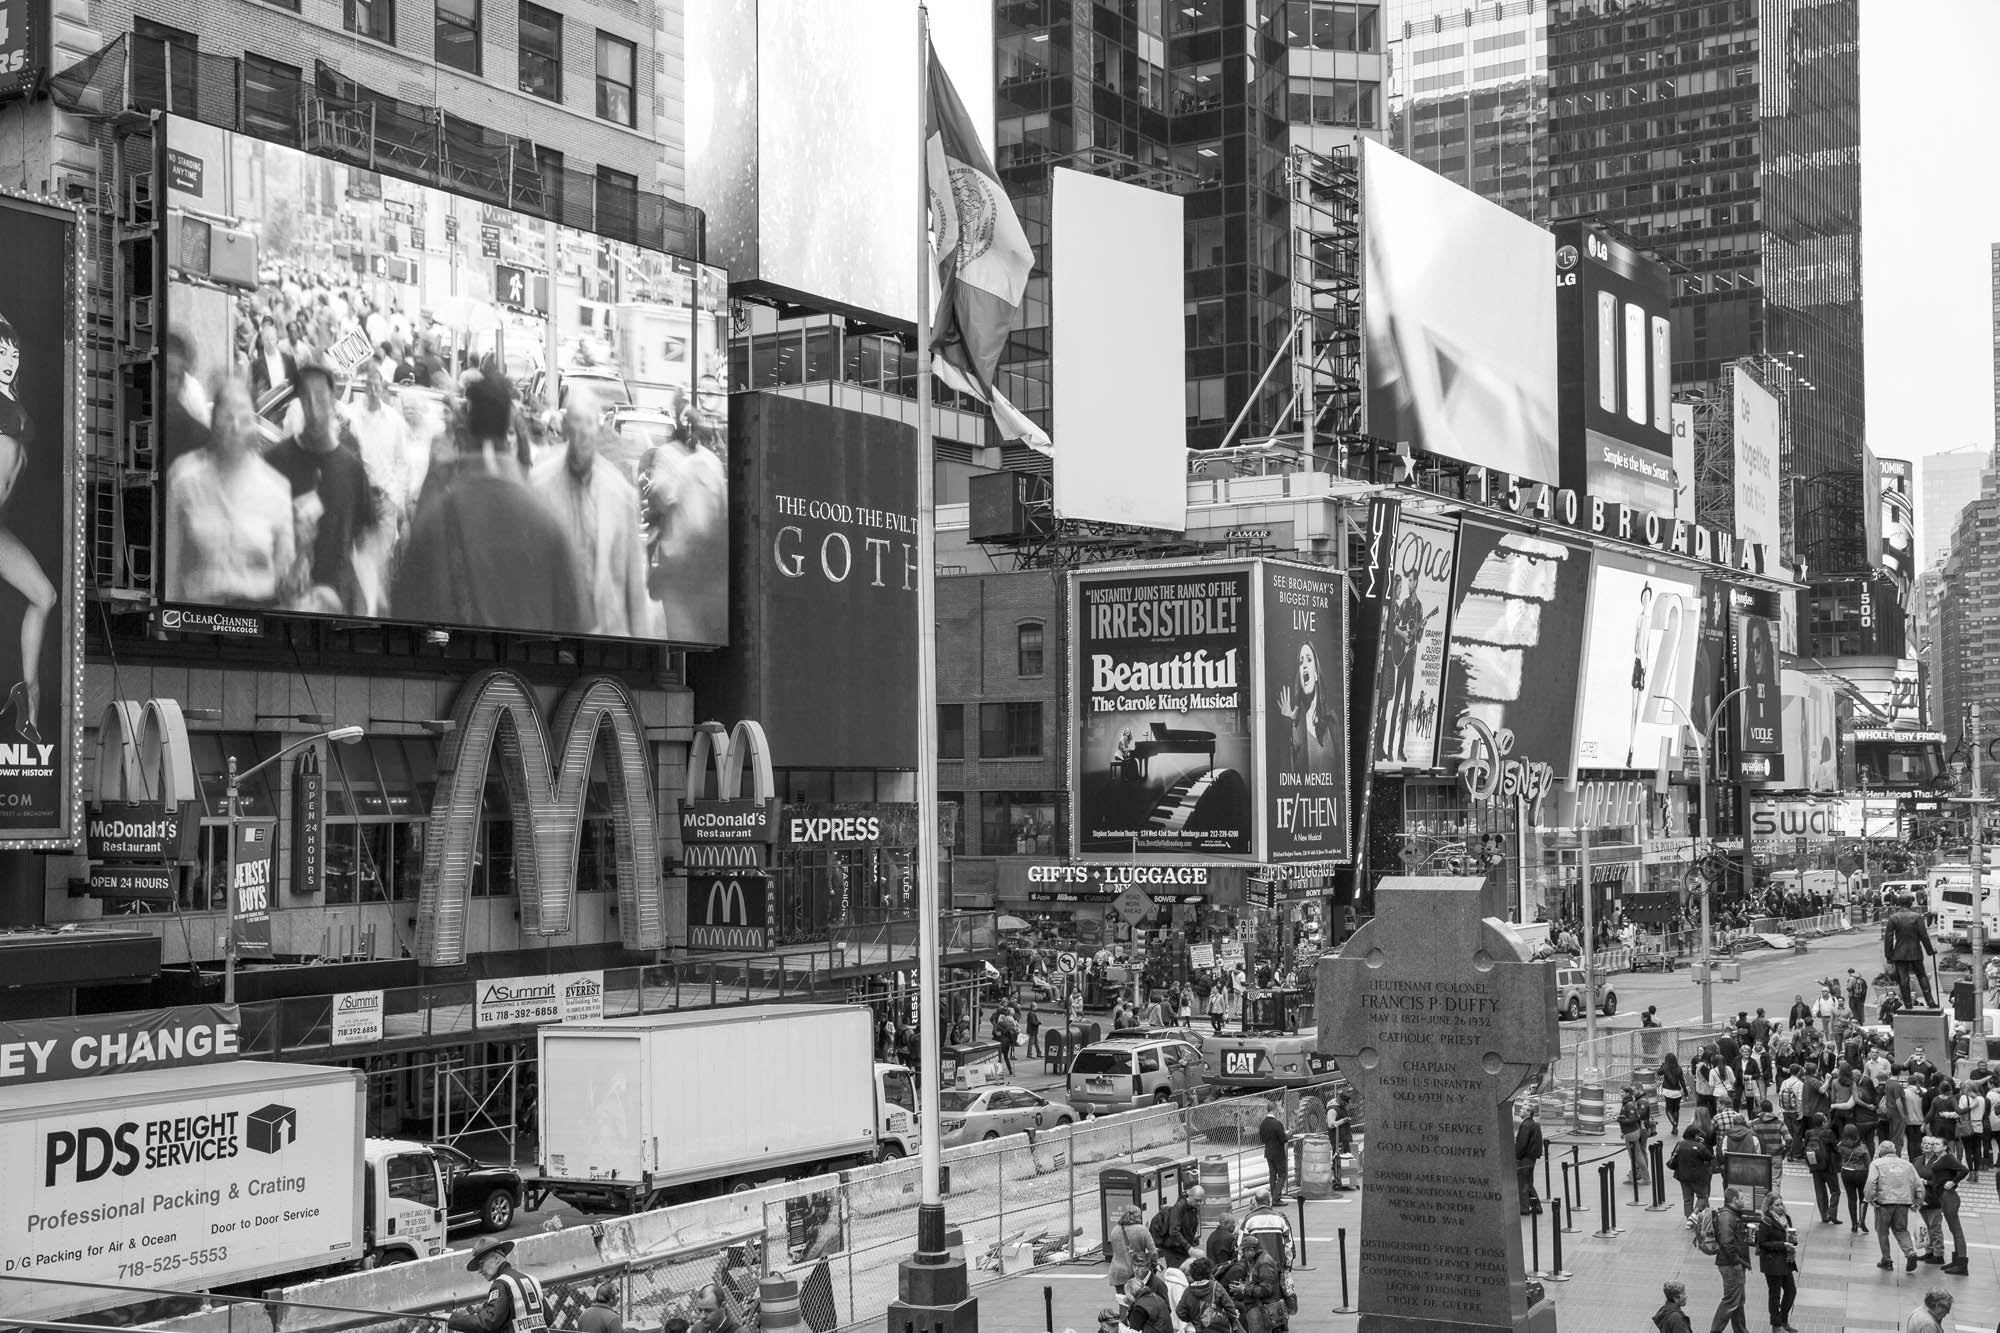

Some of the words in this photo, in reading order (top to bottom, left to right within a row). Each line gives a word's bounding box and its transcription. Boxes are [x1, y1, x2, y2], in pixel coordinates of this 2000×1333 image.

[1597, 240, 1607, 261] LG
[1557, 273, 1576, 287] LG
[1604, 447, 1624, 469] Simple
[1640, 459, 1652, 475] New
[776, 495, 806, 517] THE
[809, 501, 853, 523] GOOD.
[856, 507, 883, 527] THE
[1133, 585, 1159, 602] JOINS
[1159, 584, 1175, 600] THE
[1177, 583, 1206, 599] RANKS
[1208, 582, 1220, 597] OF
[1221, 581, 1237, 596] THE
[1273, 575, 1287, 589] SEE
[1288, 577, 1334, 595] BROADWAY'S
[1279, 590, 1309, 606] BIGGEST
[1312, 595, 1329, 609] STAR
[1861, 582, 1871, 627] 1500
[213, 624, 258, 634] SPECTACOLOR
[1293, 610, 1316, 632] LIVE
[1092, 648, 1237, 692] Beautiful
[1092, 696, 1116, 712] The
[1116, 695, 1156, 711] Carole
[1158, 694, 1188, 713] King
[1190, 692, 1238, 709] Musical
[1751, 727, 1774, 741] VOGUE
[22, 768, 54, 777] HISTORY
[1279, 772, 1301, 786] IDINA
[1304, 772, 1333, 786] MENZEL
[1573, 781, 1643, 826] FOREVER
[305, 823, 317, 833] 24
[683, 812, 766, 827] McDonald's
[90, 820, 177, 839] McDonald's
[697, 829, 751, 839] Restaurant
[791, 816, 880, 843] EXPRESS
[103, 841, 161, 853] Restaurant
[234, 859, 270, 888] JERSEY
[1027, 866, 1088, 883] GIFTS
[1105, 867, 1207, 884] LUGGAGE
[1294, 864, 1335, 879] LUGGAGE
[91, 876, 117, 888] OPEN
[120, 877, 132, 889] 24
[135, 877, 169, 890] HOURS
[239, 885, 267, 912] BOYS
[1154, 895, 1176, 903] BOWER
[496, 983, 555, 1000] Summit
[565, 984, 601, 998] EVEREST
[1369, 980, 1433, 992] LIEUTENANT
[1435, 982, 1488, 994] COLONEL
[1360, 994, 1424, 1011] FRANCIS
[1445, 997, 1499, 1013] DUFFY
[481, 1012, 493, 1022] TEL
[496, 1006, 558, 1020] 718-392-6858
[1454, 1016, 1466, 1026] 26
[70, 1023, 239, 1070] CHANGE
[1378, 1031, 1434, 1043] CATHOLIC
[1440, 1034, 1481, 1046] PRIEST
[1226, 1052, 1257, 1075] CAT
[1403, 1060, 1456, 1073] CHAPLAIN
[1393, 1091, 1415, 1101] OLD
[1393, 1120, 1417, 1131] LIFE
[1438, 1122, 1484, 1135] SERVICE
[45, 1121, 140, 1188] PDS
[145, 1111, 239, 1146] FREIGHT
[144, 1135, 239, 1170] SERVICES
[1377, 1141, 1403, 1152] GOD
[1406, 1143, 1430, 1154] AND
[1433, 1145, 1487, 1158] COUNTRY
[26, 1197, 145, 1234] Professional
[153, 1186, 220, 1215] Packing
[228, 1183, 240, 1199] &
[248, 1175, 306, 1198] Crating
[210, 1220, 237, 1235] Door
[240, 1217, 251, 1230] to
[255, 1213, 280, 1229] Door
[283, 1207, 320, 1224] Service
[5, 1253, 31, 1272] D/G
[36, 1247, 83, 1267] Packing
[87, 1242, 104, 1256] for
[107, 1240, 124, 1253] Air
[128, 1237, 137, 1249] &
[141, 1232, 177, 1248] Ocean
[118, 1246, 228, 1280] 718-525-5553
